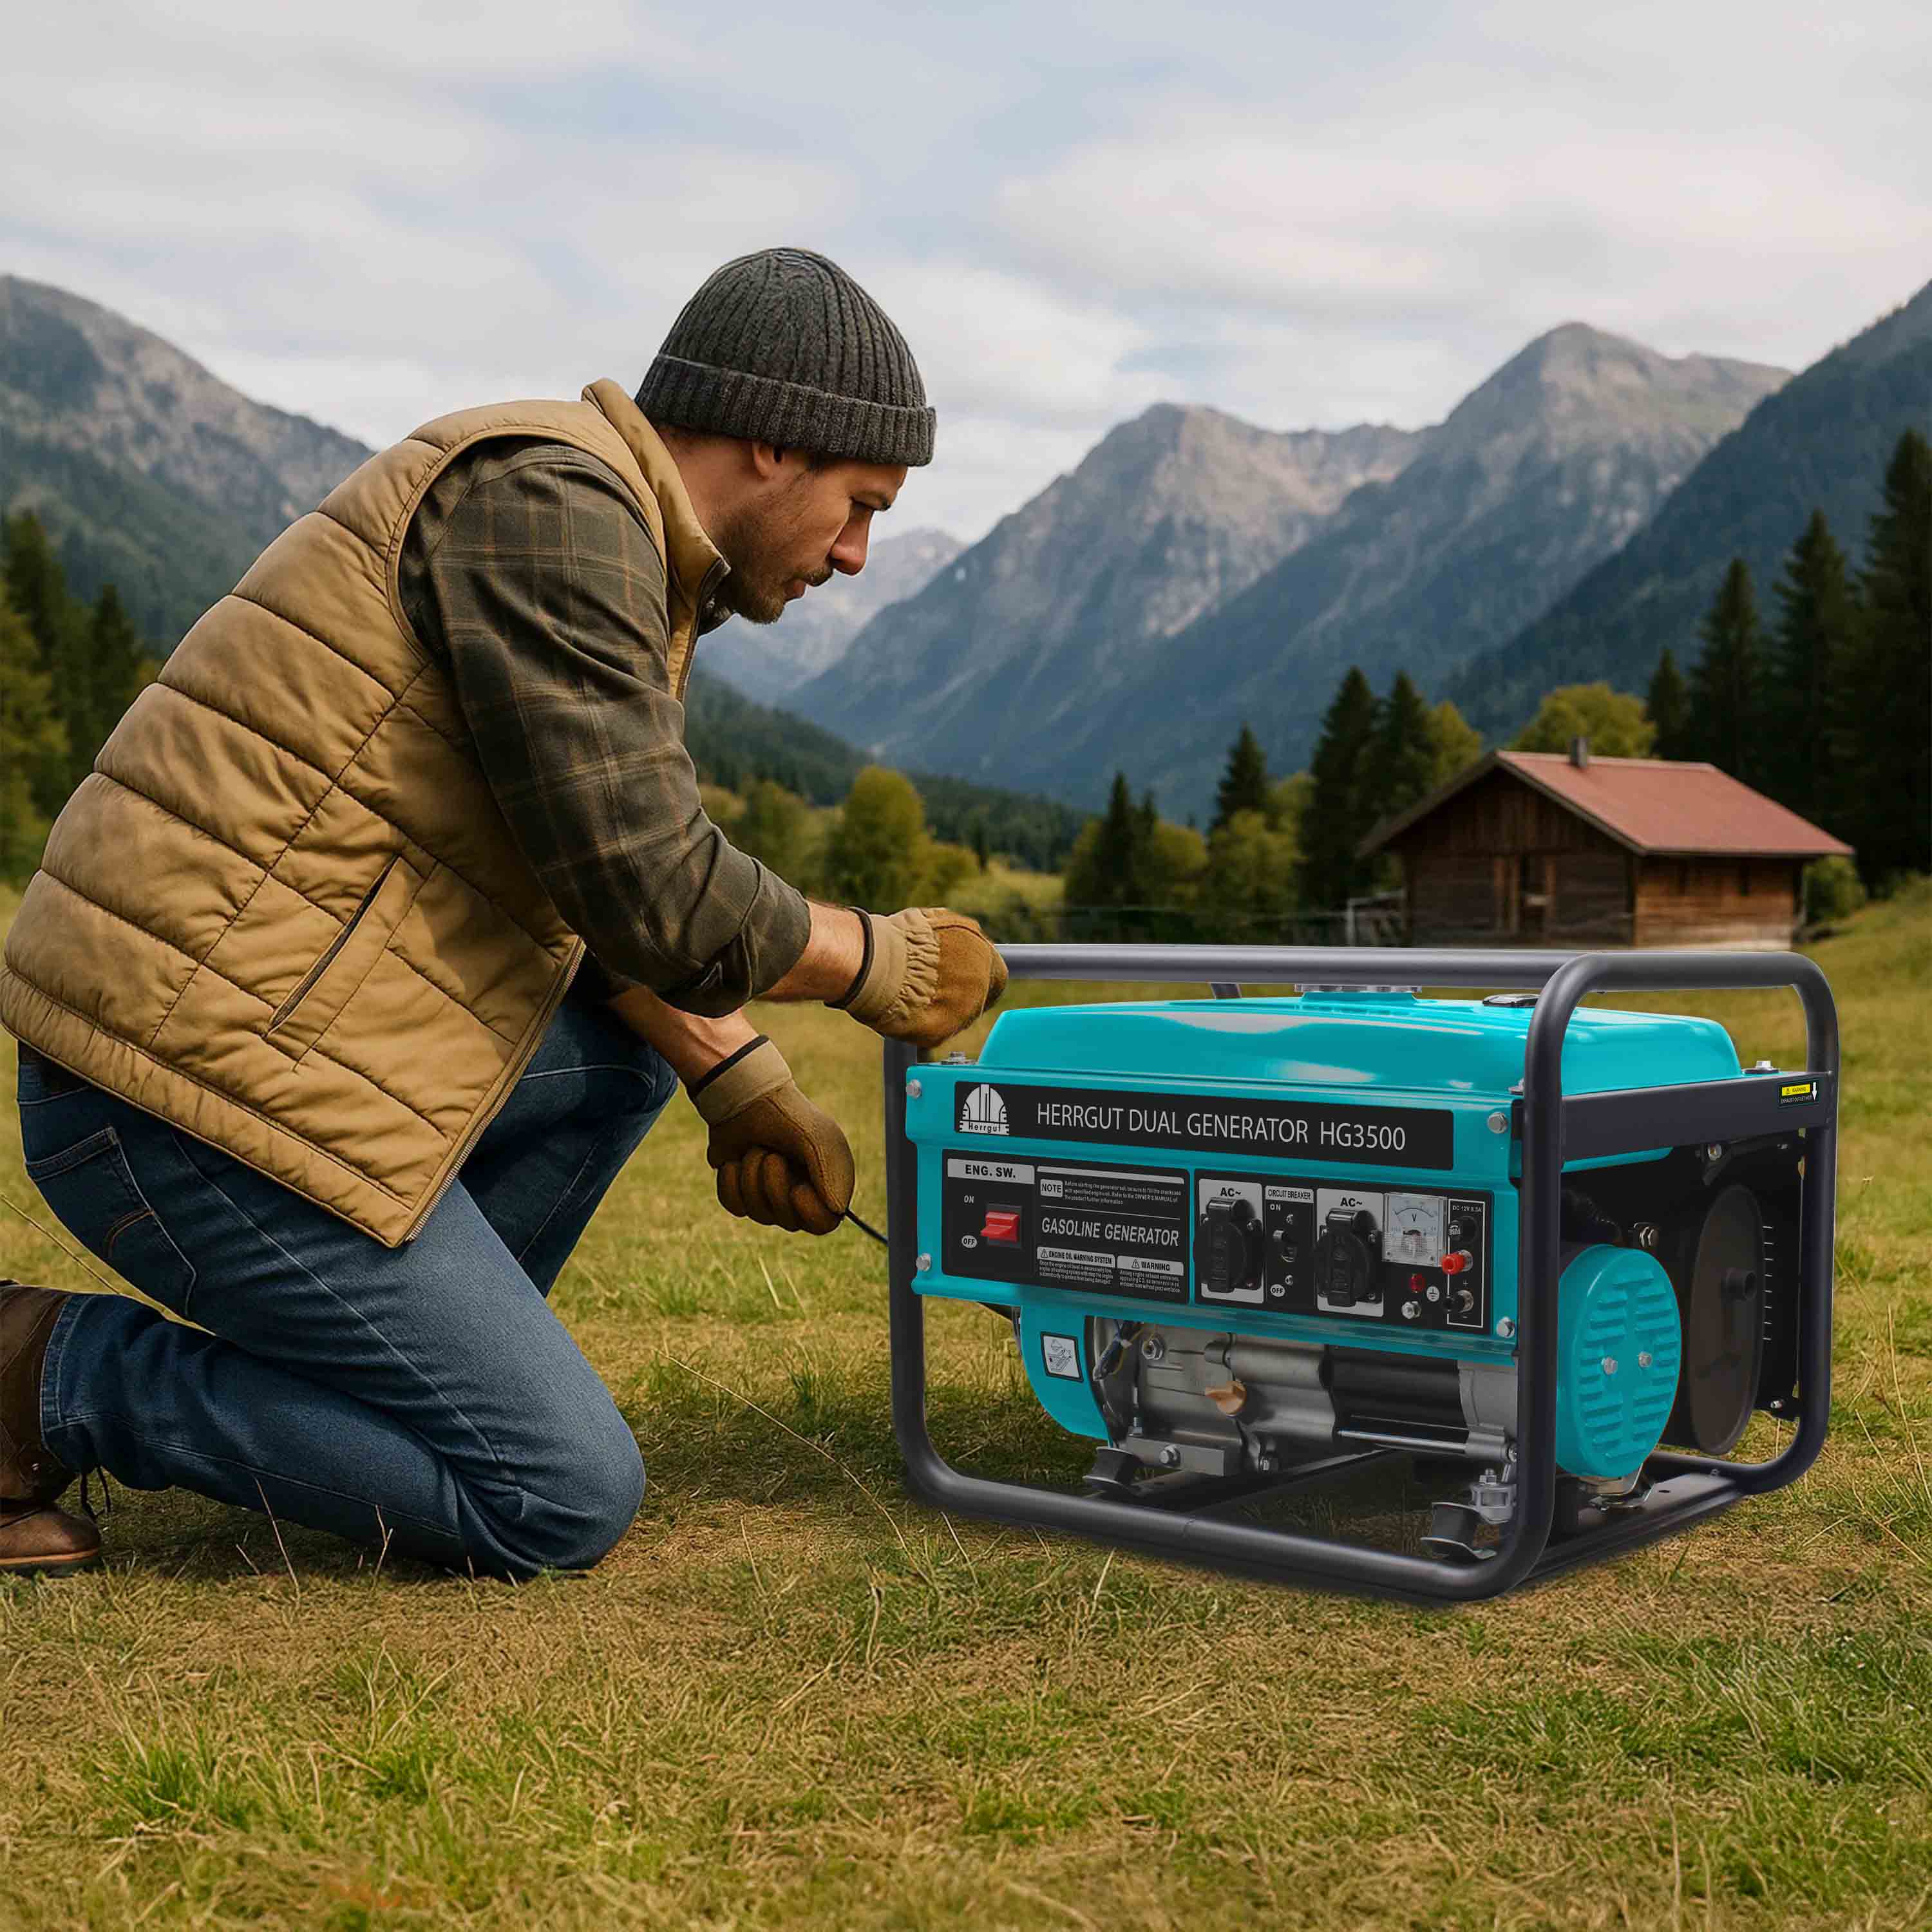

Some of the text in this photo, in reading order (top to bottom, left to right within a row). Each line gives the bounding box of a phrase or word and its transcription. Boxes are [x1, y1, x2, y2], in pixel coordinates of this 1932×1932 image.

[968, 1122, 1001, 1133] Herrgut
[1037, 1103, 1406, 1151] HERRGUT DUAL GENERATOR HG3500
[965, 1164, 1016, 1178] ENG. SW.
[1041, 1183, 1062, 1193] NOTE
[963, 1195, 974, 1204] ON
[1267, 1189, 1311, 1200] CIRCUIT BREAKER
[1412, 1213, 1417, 1222] V
[1041, 1217, 1179, 1247] GASOLINE GENERATOR
[1048, 1251, 1065, 1259] ENGINE
[1094, 1256, 1112, 1264] SYSTEM
[1141, 1262, 1170, 1271] WARNING
